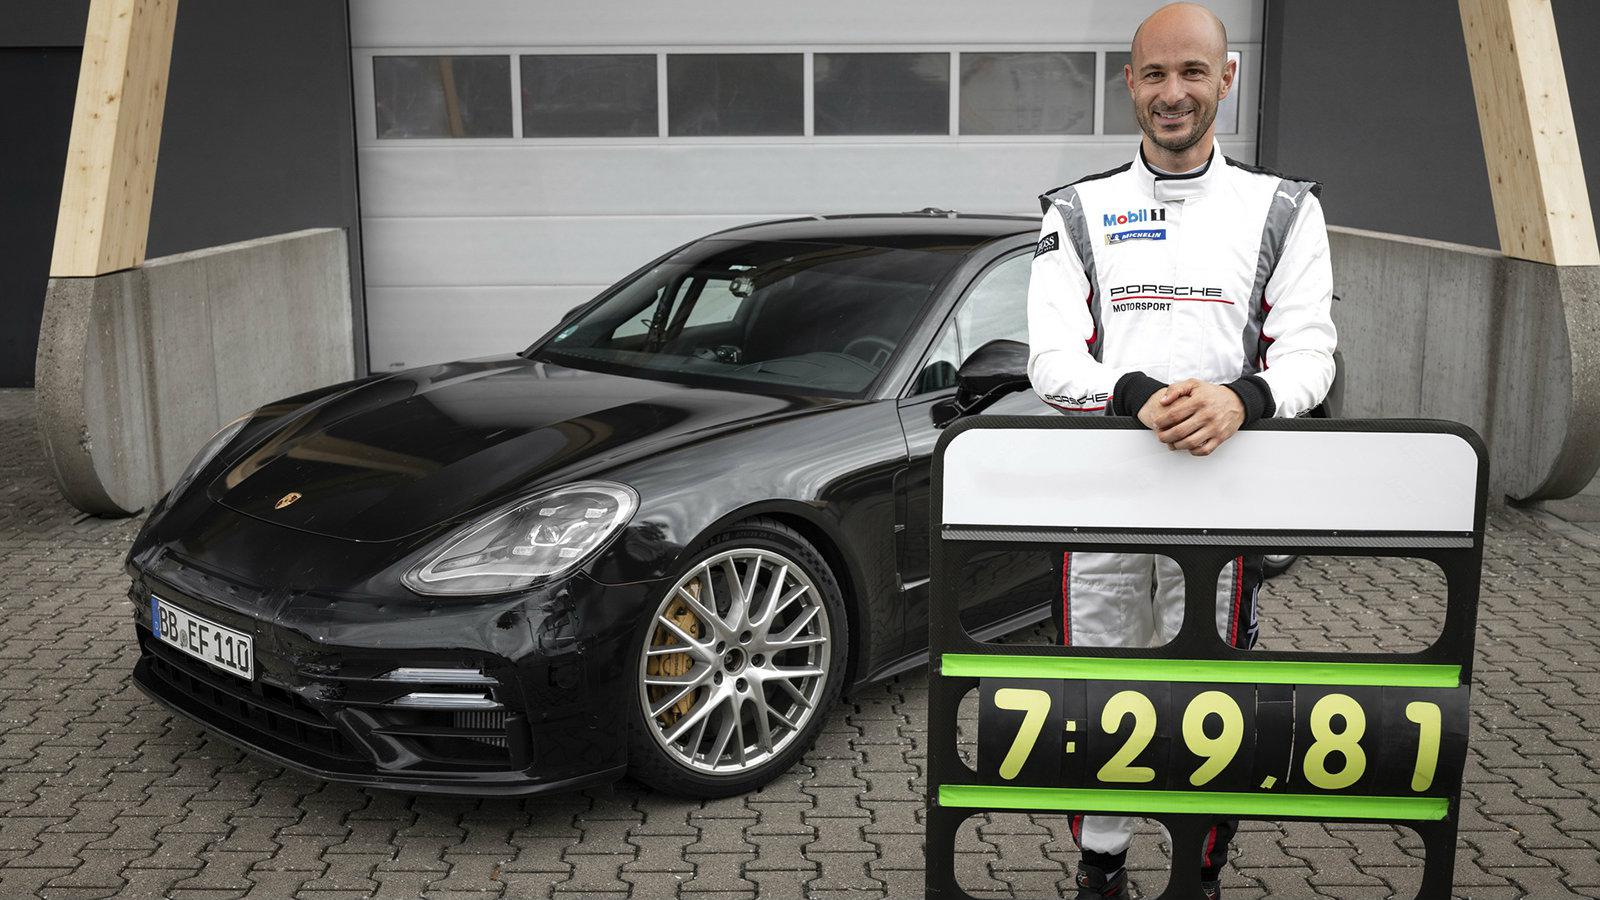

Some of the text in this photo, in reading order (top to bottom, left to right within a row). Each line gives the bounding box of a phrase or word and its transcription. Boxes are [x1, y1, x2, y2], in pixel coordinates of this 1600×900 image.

[1103, 208, 1147, 227] Mobil
[1121, 232, 1162, 241] MICHELIN
[1110, 284, 1223, 298] PORSCHE
[1112, 302, 1172, 313] MOTORSPORT
[1044, 392, 1109, 406] PORSCHE
[159, 607, 250, 672] BB EF 110
